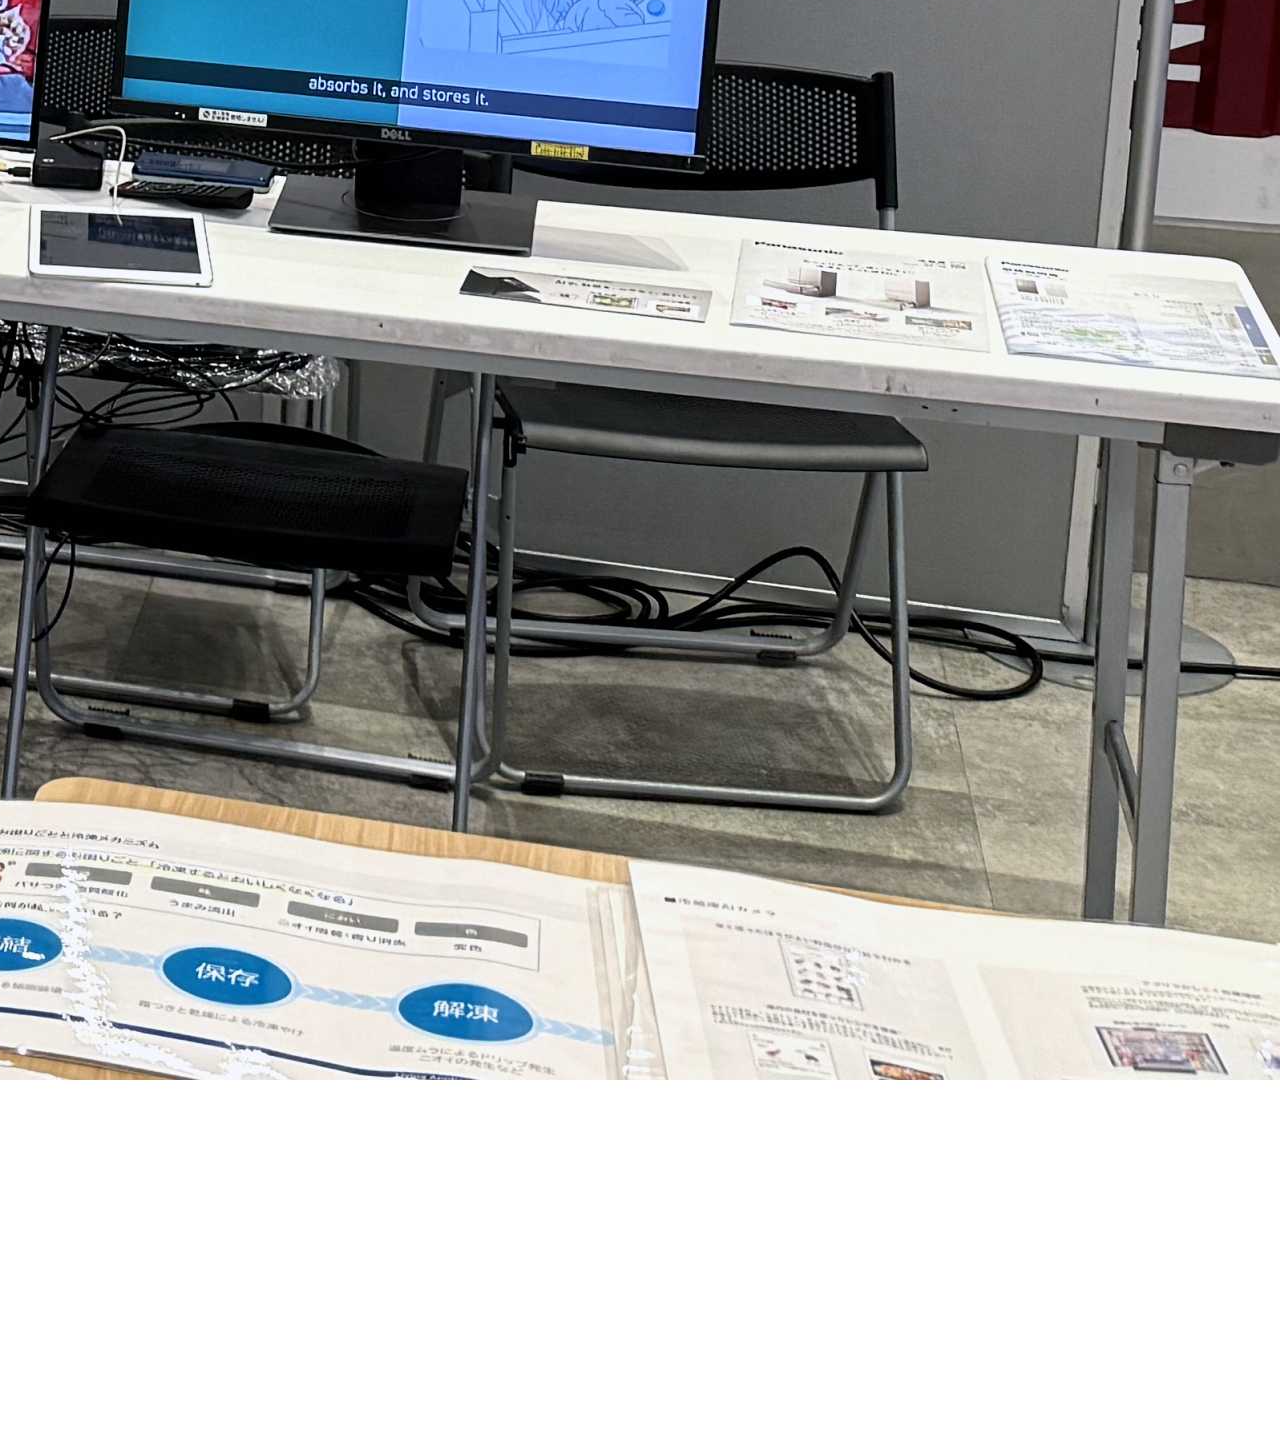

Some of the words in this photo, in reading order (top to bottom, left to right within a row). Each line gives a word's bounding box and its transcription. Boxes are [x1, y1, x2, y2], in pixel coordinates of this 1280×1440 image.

[308, 75, 369, 96] absorbs
[372, 80, 387, 100] it,
[390, 82, 419, 100] and
[422, 86, 471, 105] stores
[474, 90, 489, 106] it.
[380, 127, 412, 141] DELL
[195, 961, 260, 988] 保存
[432, 999, 500, 1024] 解凍
